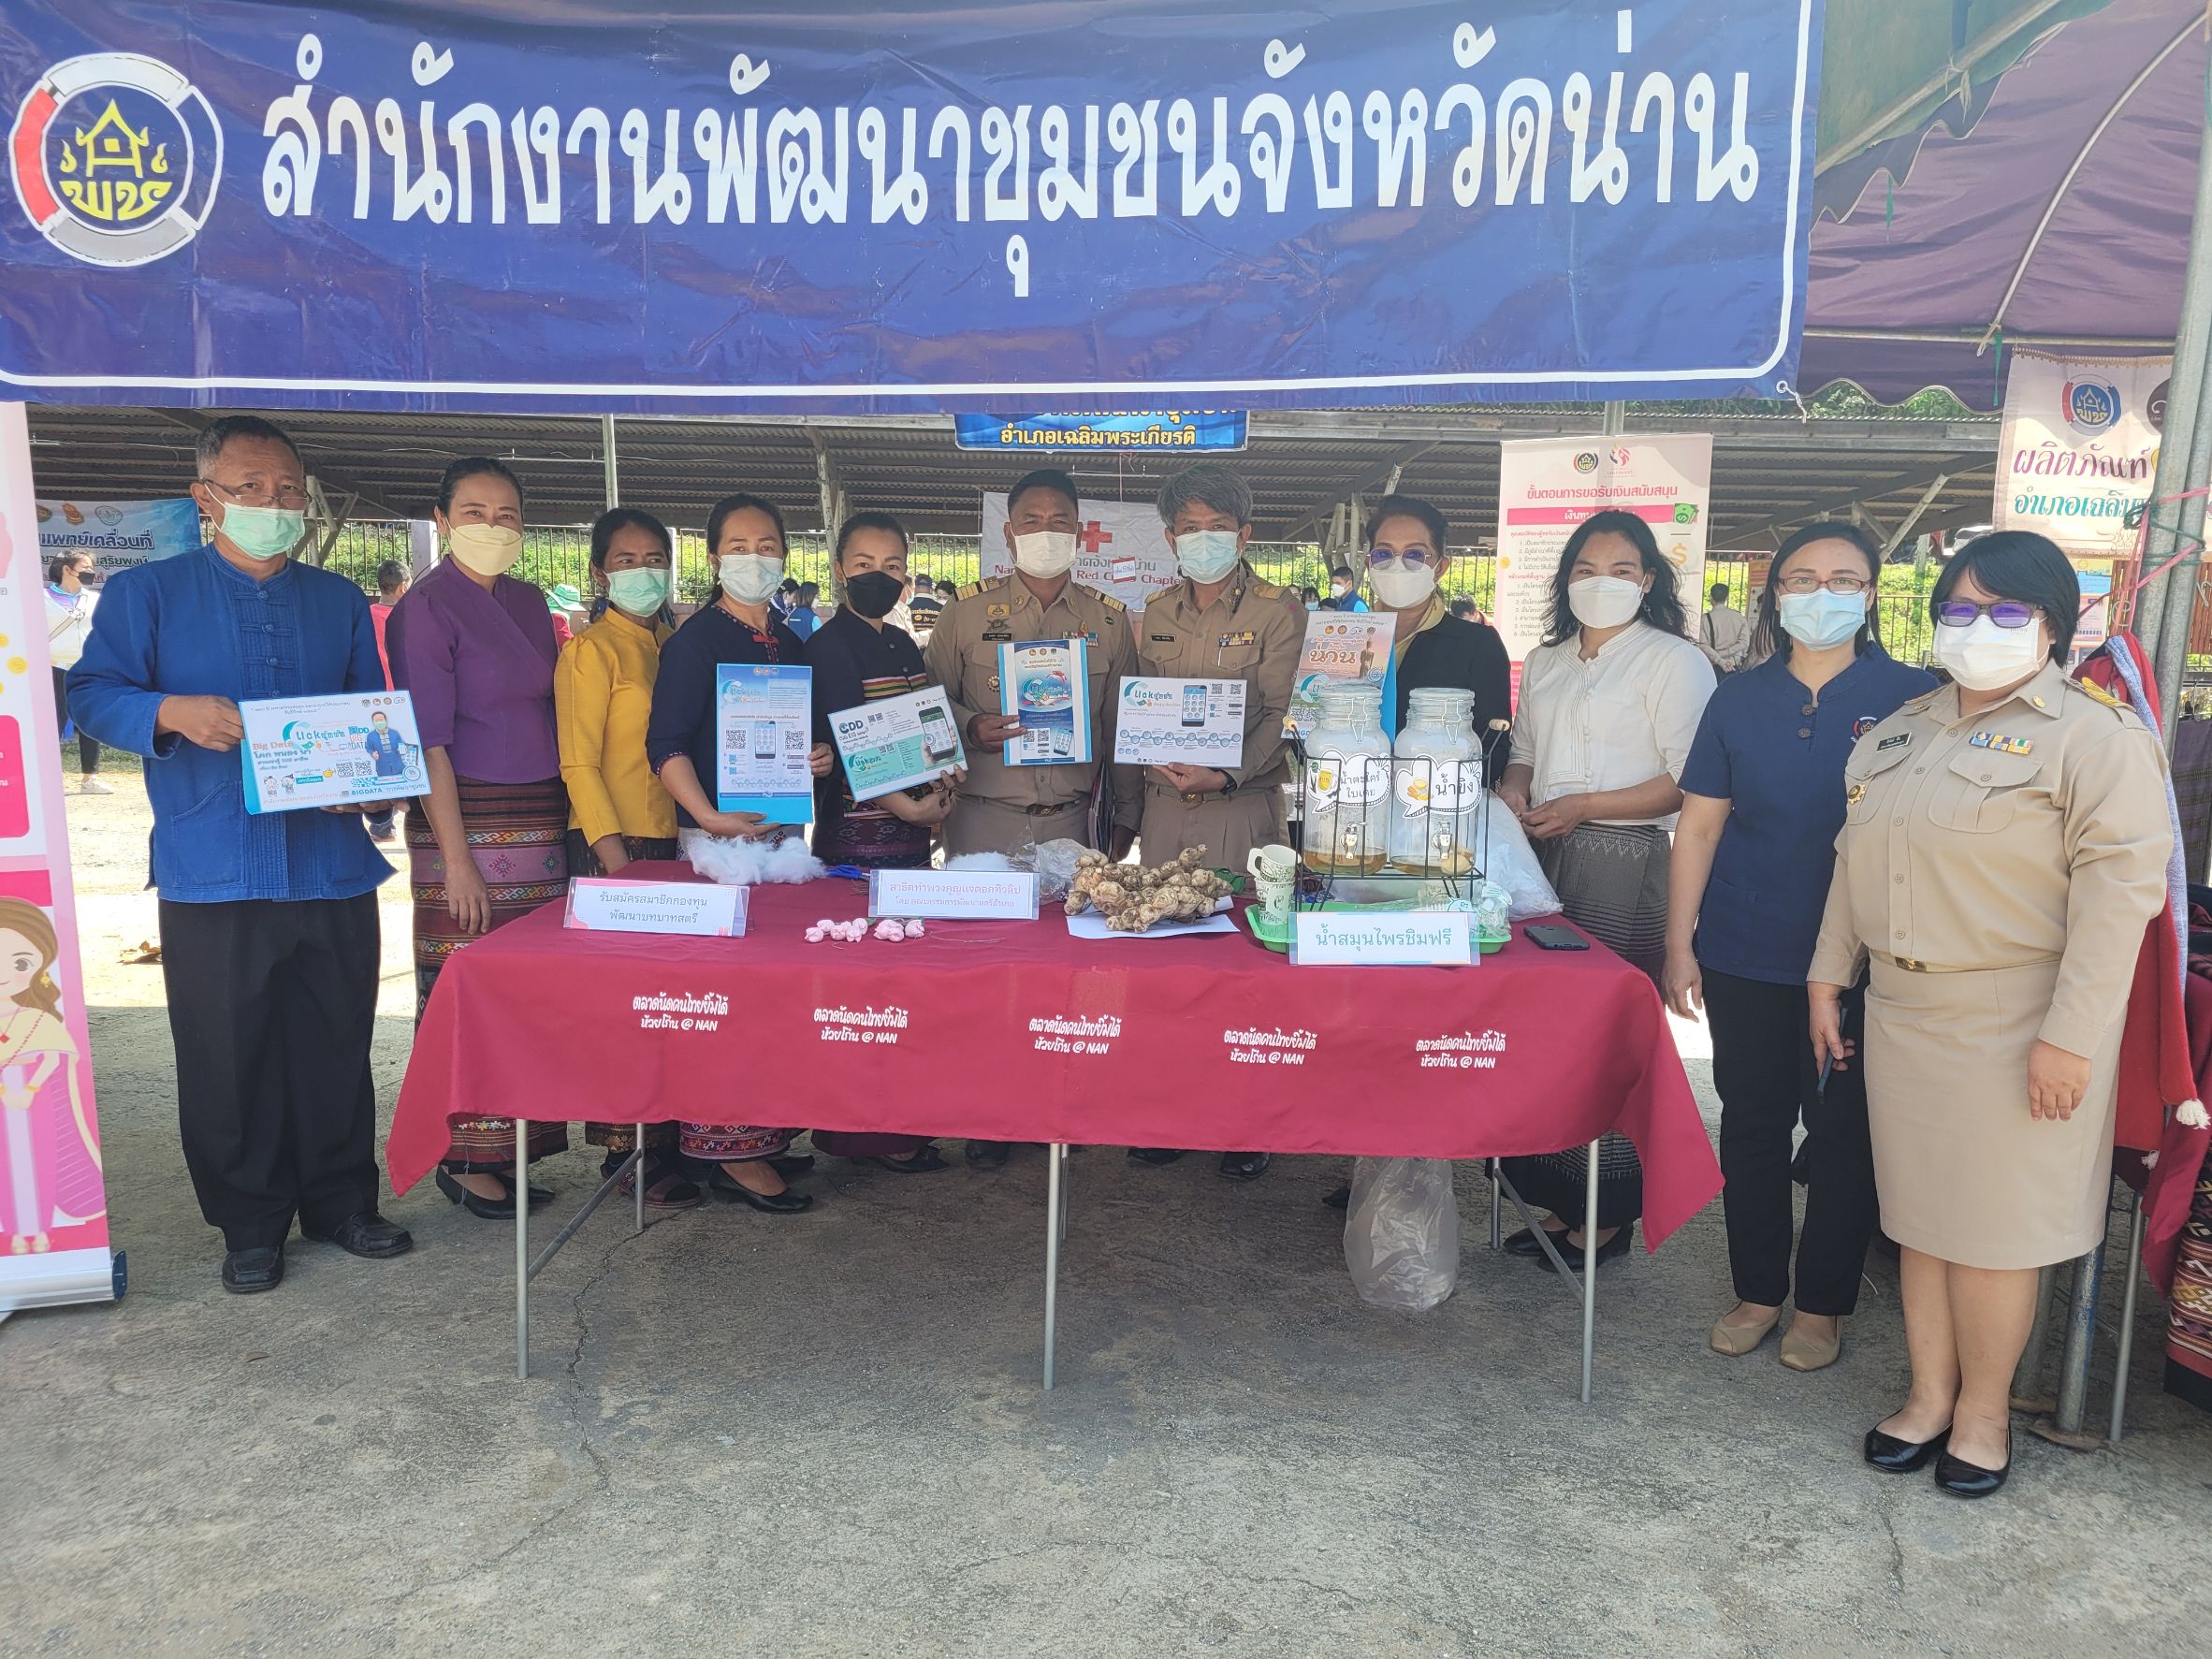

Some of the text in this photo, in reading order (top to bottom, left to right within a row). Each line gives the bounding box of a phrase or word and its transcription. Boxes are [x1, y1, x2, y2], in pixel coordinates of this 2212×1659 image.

[254, 9, 1759, 298] สำนักงานพัฒนาชุมชนจังหวัดน่าน
[1000, 423, 1196, 445] อำเภอเฉลิมพระเกียรติ
[2014, 441, 2150, 479] ผลิตภัณฑ์
[1527, 485, 1678, 500] ขั้นตอนการขอรับเงินสนับสนุน
[1076, 570, 1099, 580] Red
[1309, 642, 1357, 664] น่าน
[1434, 774, 1475, 797] น้ำขิง
[599, 891, 708, 910] รับสมัครสมาชิกกองทุน
[609, 909, 699, 924] พัฒนาบทบาทสตรี
[1316, 923, 1452, 952] น้ำสมุนไพรชิมฟรี
[633, 991, 729, 1016] ตลาดนัดคนไทยยิ้มได้
[681, 1018, 694, 1030] @
[695, 1020, 719, 1032] NAN
[813, 1005, 909, 1029] ตลาดนัดคนไทยยิ้มได้
[1028, 1014, 1122, 1038] ตลาดนัดคนไทยยิ้มได้
[862, 1032, 875, 1043] @
[875, 1032, 898, 1044] NAN
[1072, 1041, 1086, 1055] @
[1086, 1043, 1110, 1055] NAN
[1223, 1026, 1317, 1050] ตลาดนัดคนไทยยิ้มได้
[1415, 1029, 1506, 1052] ตลาดนัดคนไทยยิ้มได้
[1269, 1054, 1282, 1065] @
[1282, 1054, 1305, 1065] NAN
[1460, 1056, 1474, 1069] @
[1474, 1056, 1496, 1069] NAN
